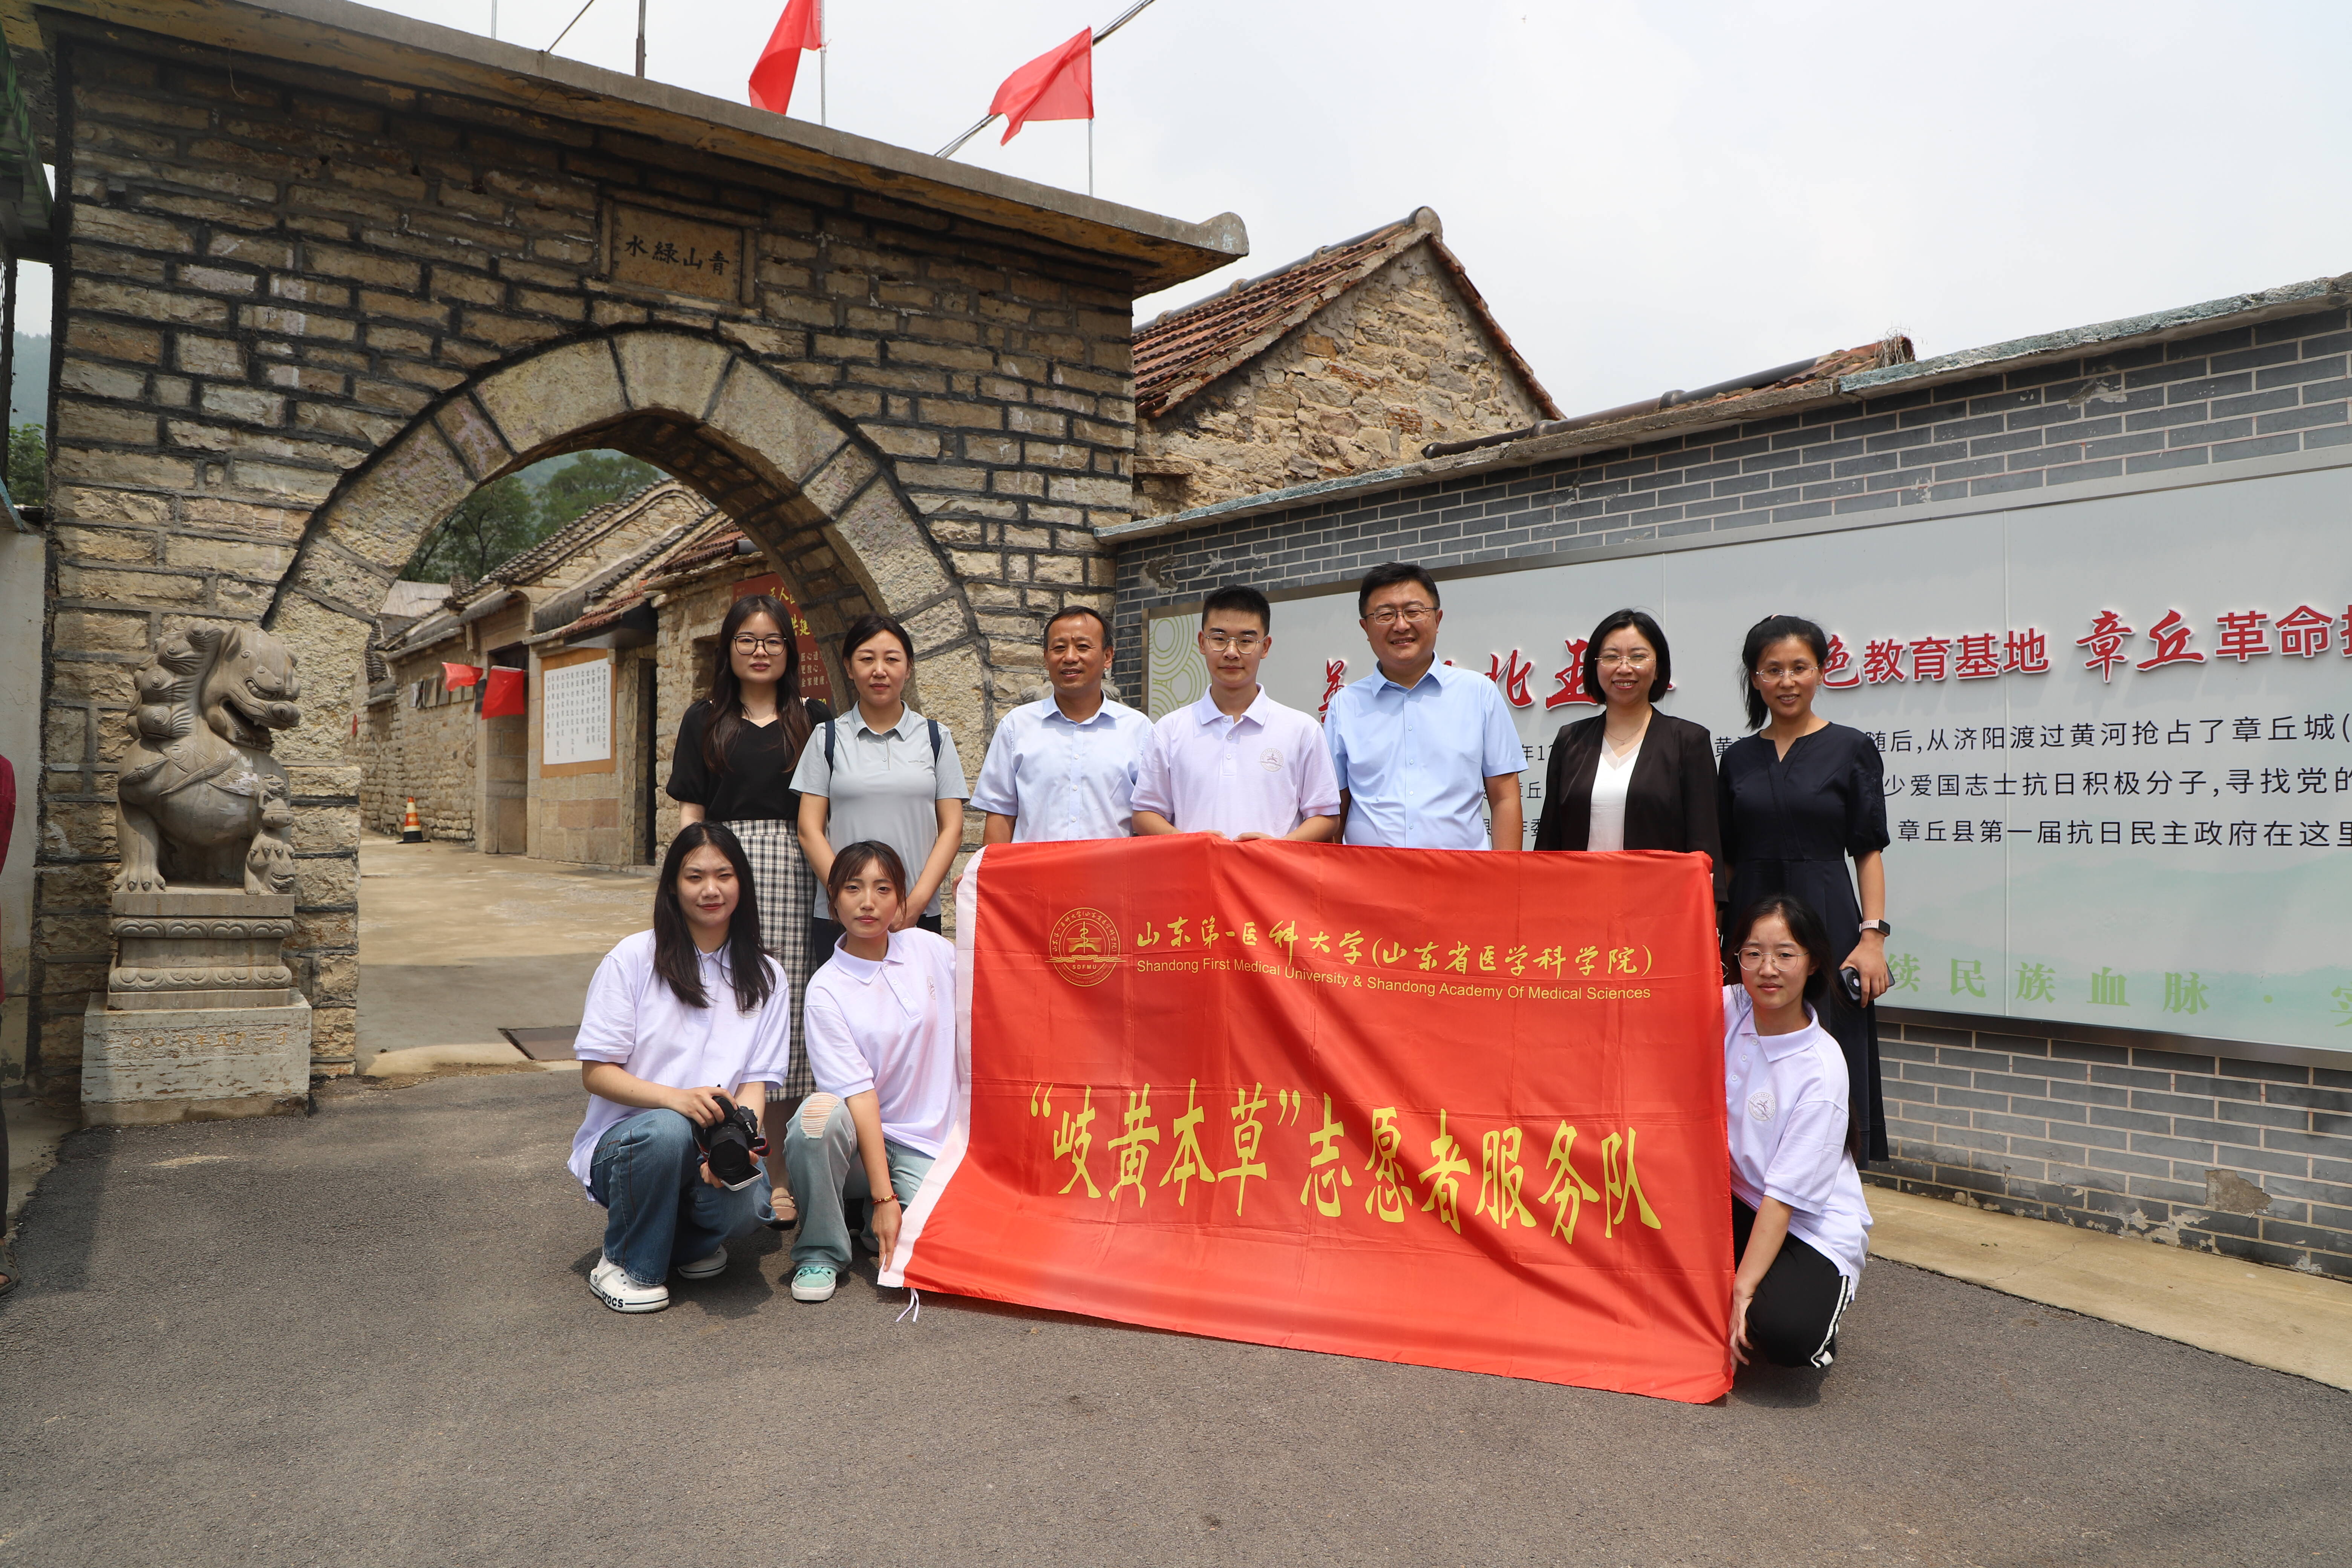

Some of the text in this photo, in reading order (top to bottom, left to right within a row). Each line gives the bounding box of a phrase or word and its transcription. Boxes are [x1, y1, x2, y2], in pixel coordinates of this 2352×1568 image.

[1519, 781, 1542, 798] 丘
[1137, 958, 1651, 1001] Shandong First Medical University & Shandong Academy Of Medical Sciences
[602, 1291, 624, 1308] crocs
